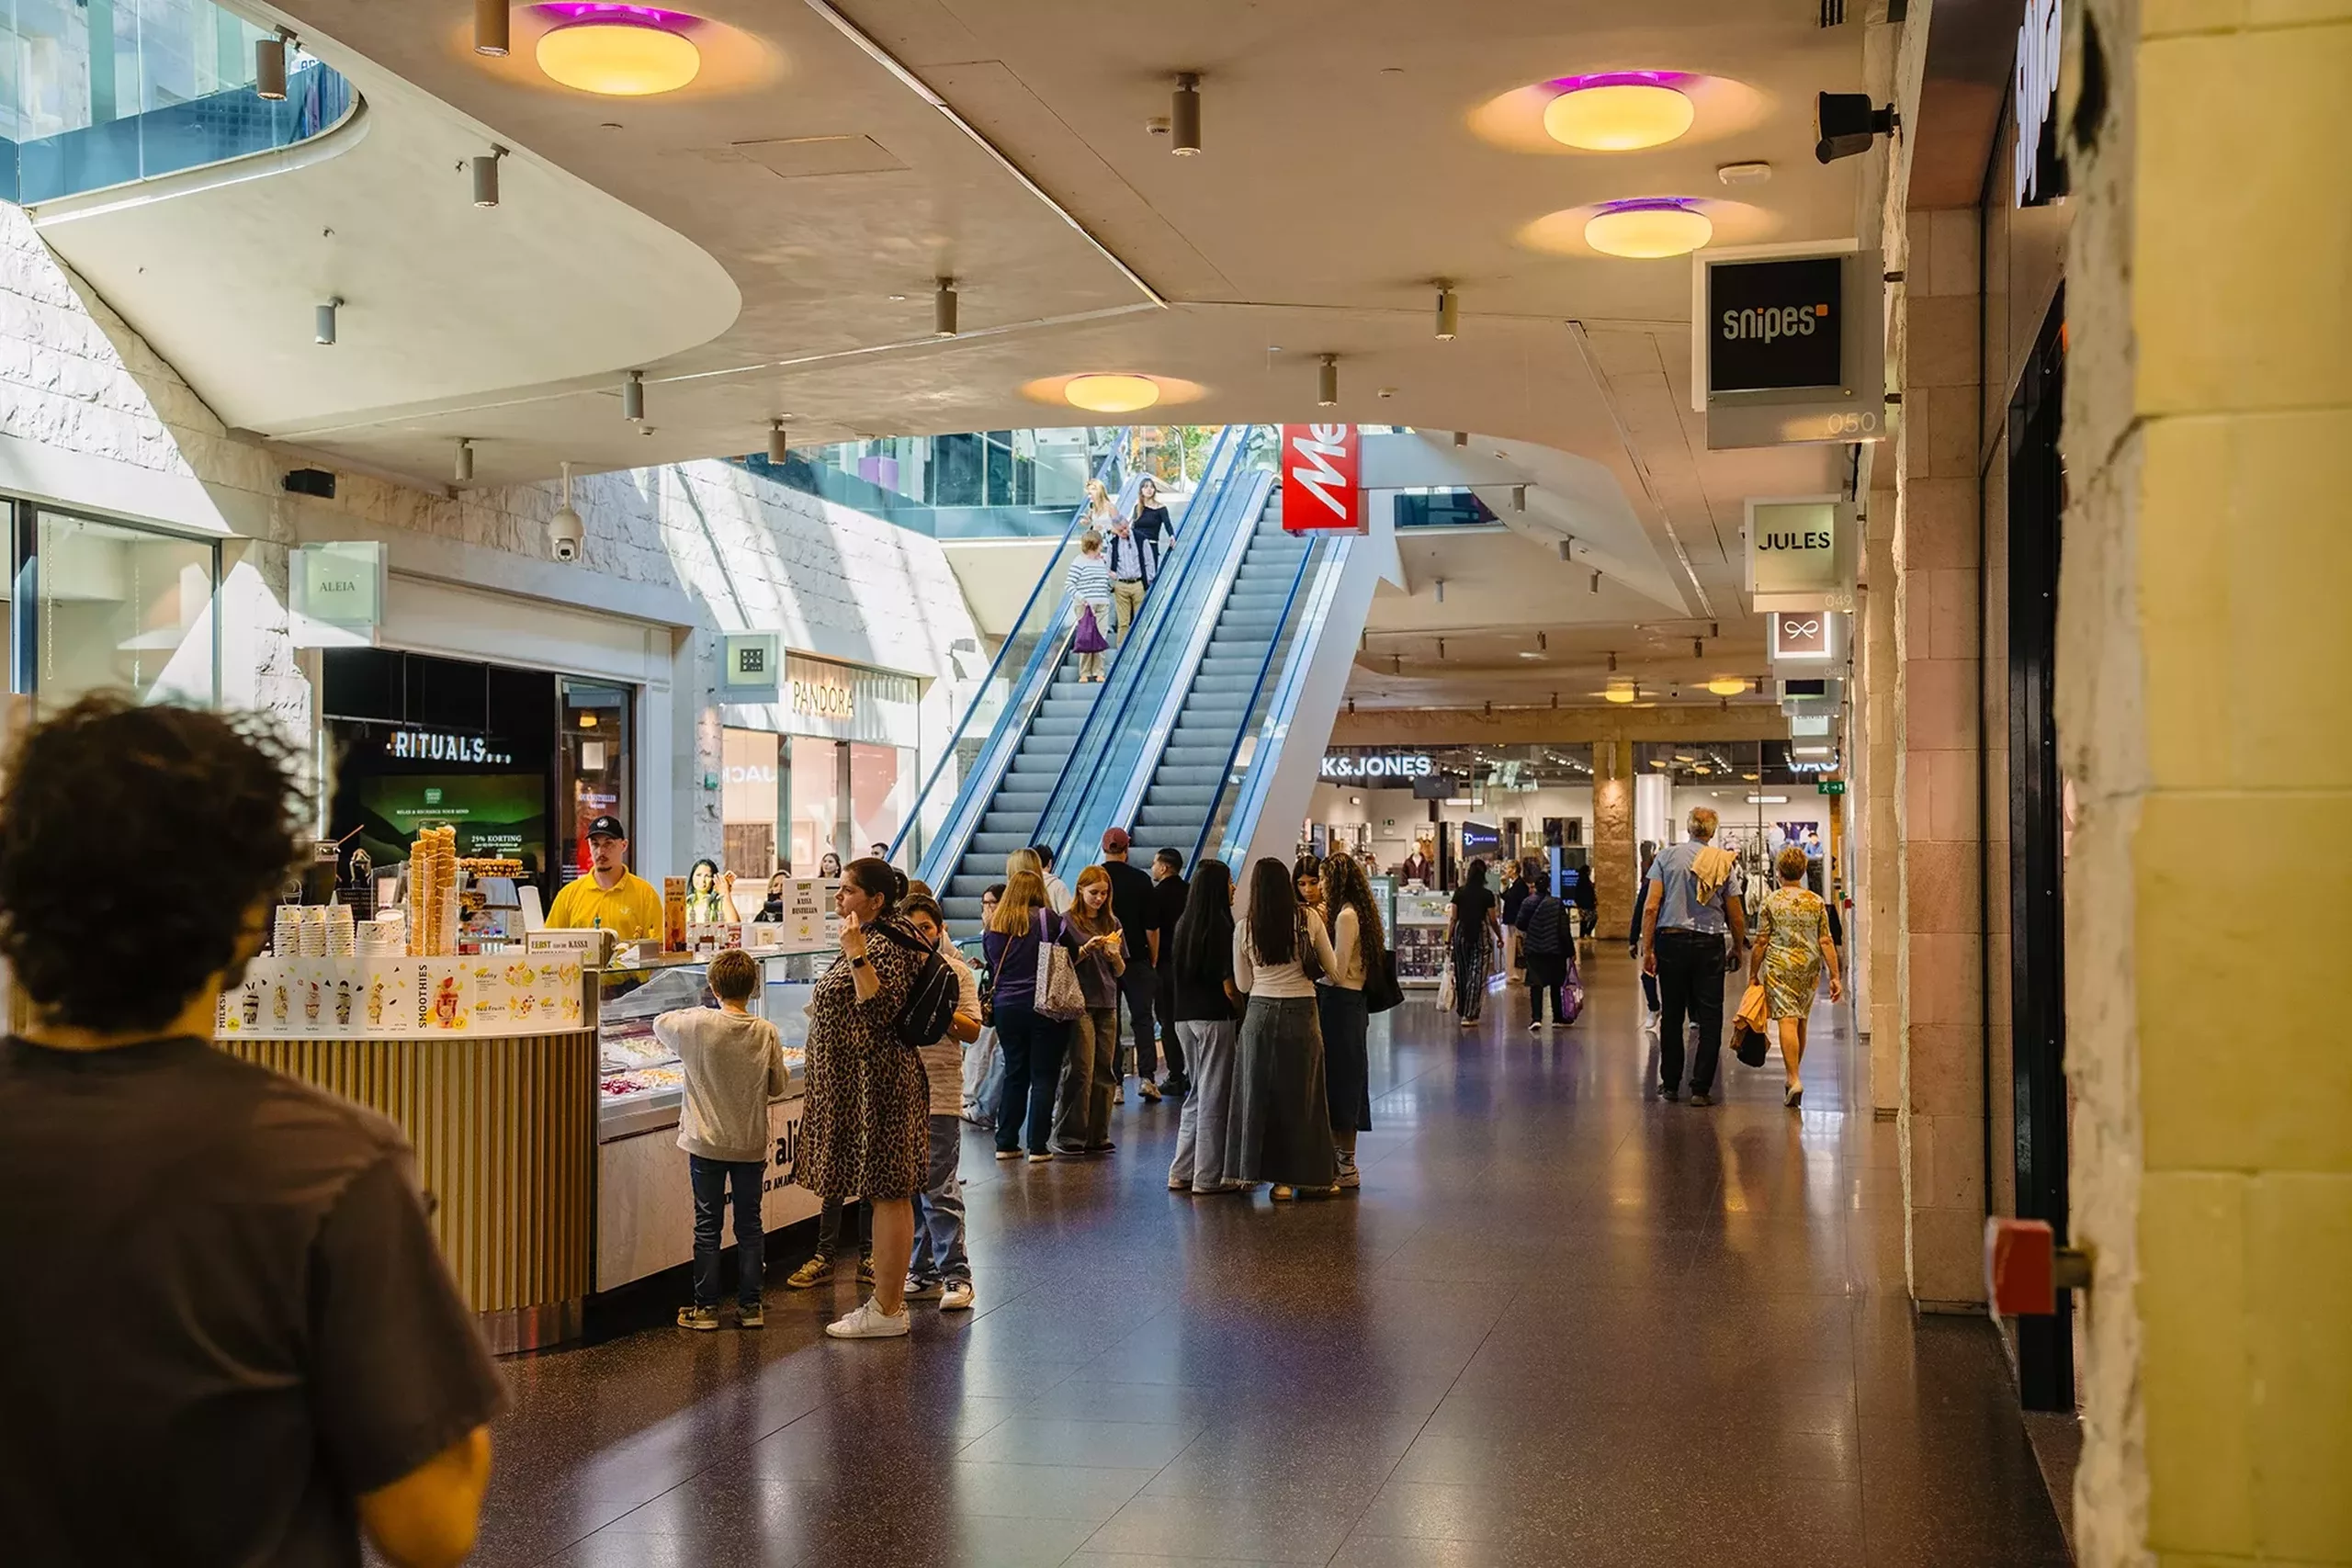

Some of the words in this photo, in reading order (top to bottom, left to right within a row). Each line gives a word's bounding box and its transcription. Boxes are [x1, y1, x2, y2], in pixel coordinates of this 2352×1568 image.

[1723, 305, 1816, 344] snipes
[1827, 412, 1876, 434] 050
[1758, 531, 1831, 551] JULES
[319, 581, 356, 592] ALEIA
[1824, 594, 1853, 607] 049
[793, 680, 855, 716] PANDORA
[1320, 755, 1432, 777] K&JONES
[487, 834, 522, 843] KORTING
[418, 964, 428, 1029] SMOOTHIES
